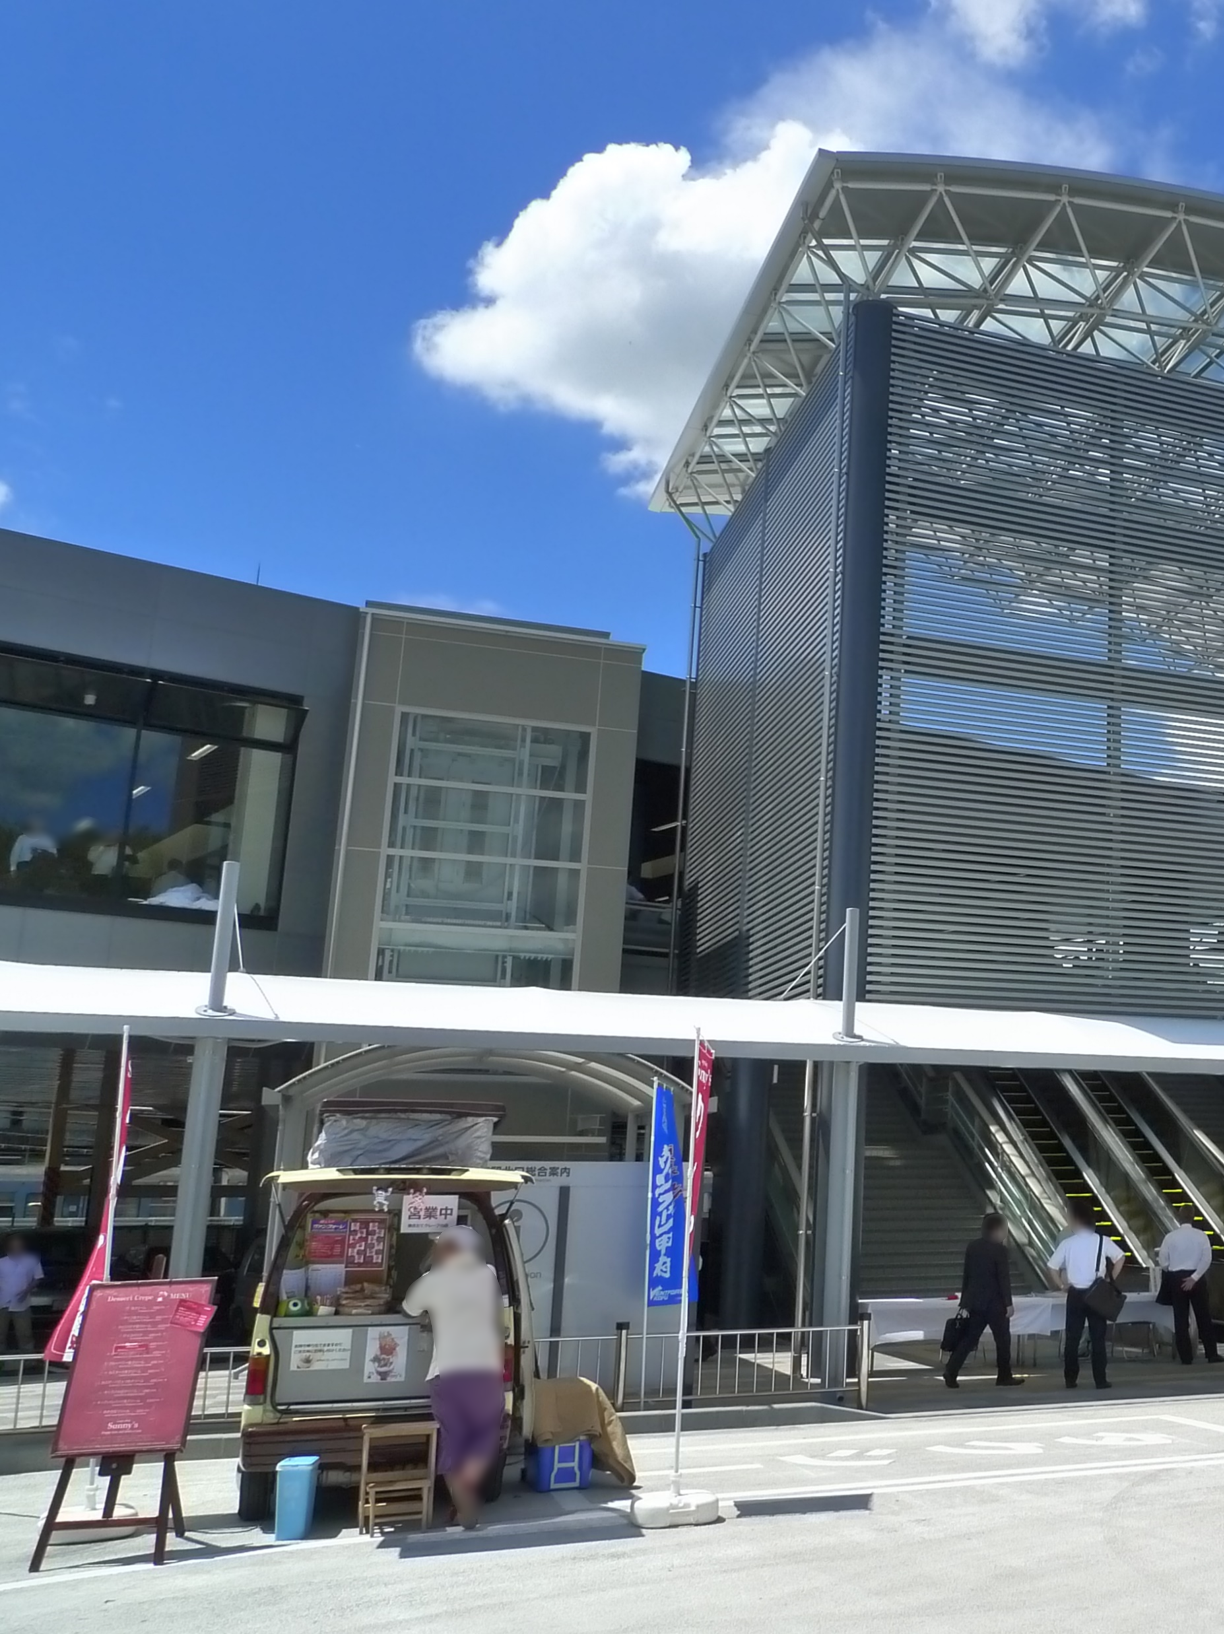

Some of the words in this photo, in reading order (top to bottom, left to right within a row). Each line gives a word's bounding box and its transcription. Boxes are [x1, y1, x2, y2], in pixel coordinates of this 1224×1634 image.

[408, 1206, 454, 1220] 営業中
[107, 1421, 139, 1430] Sunny's
